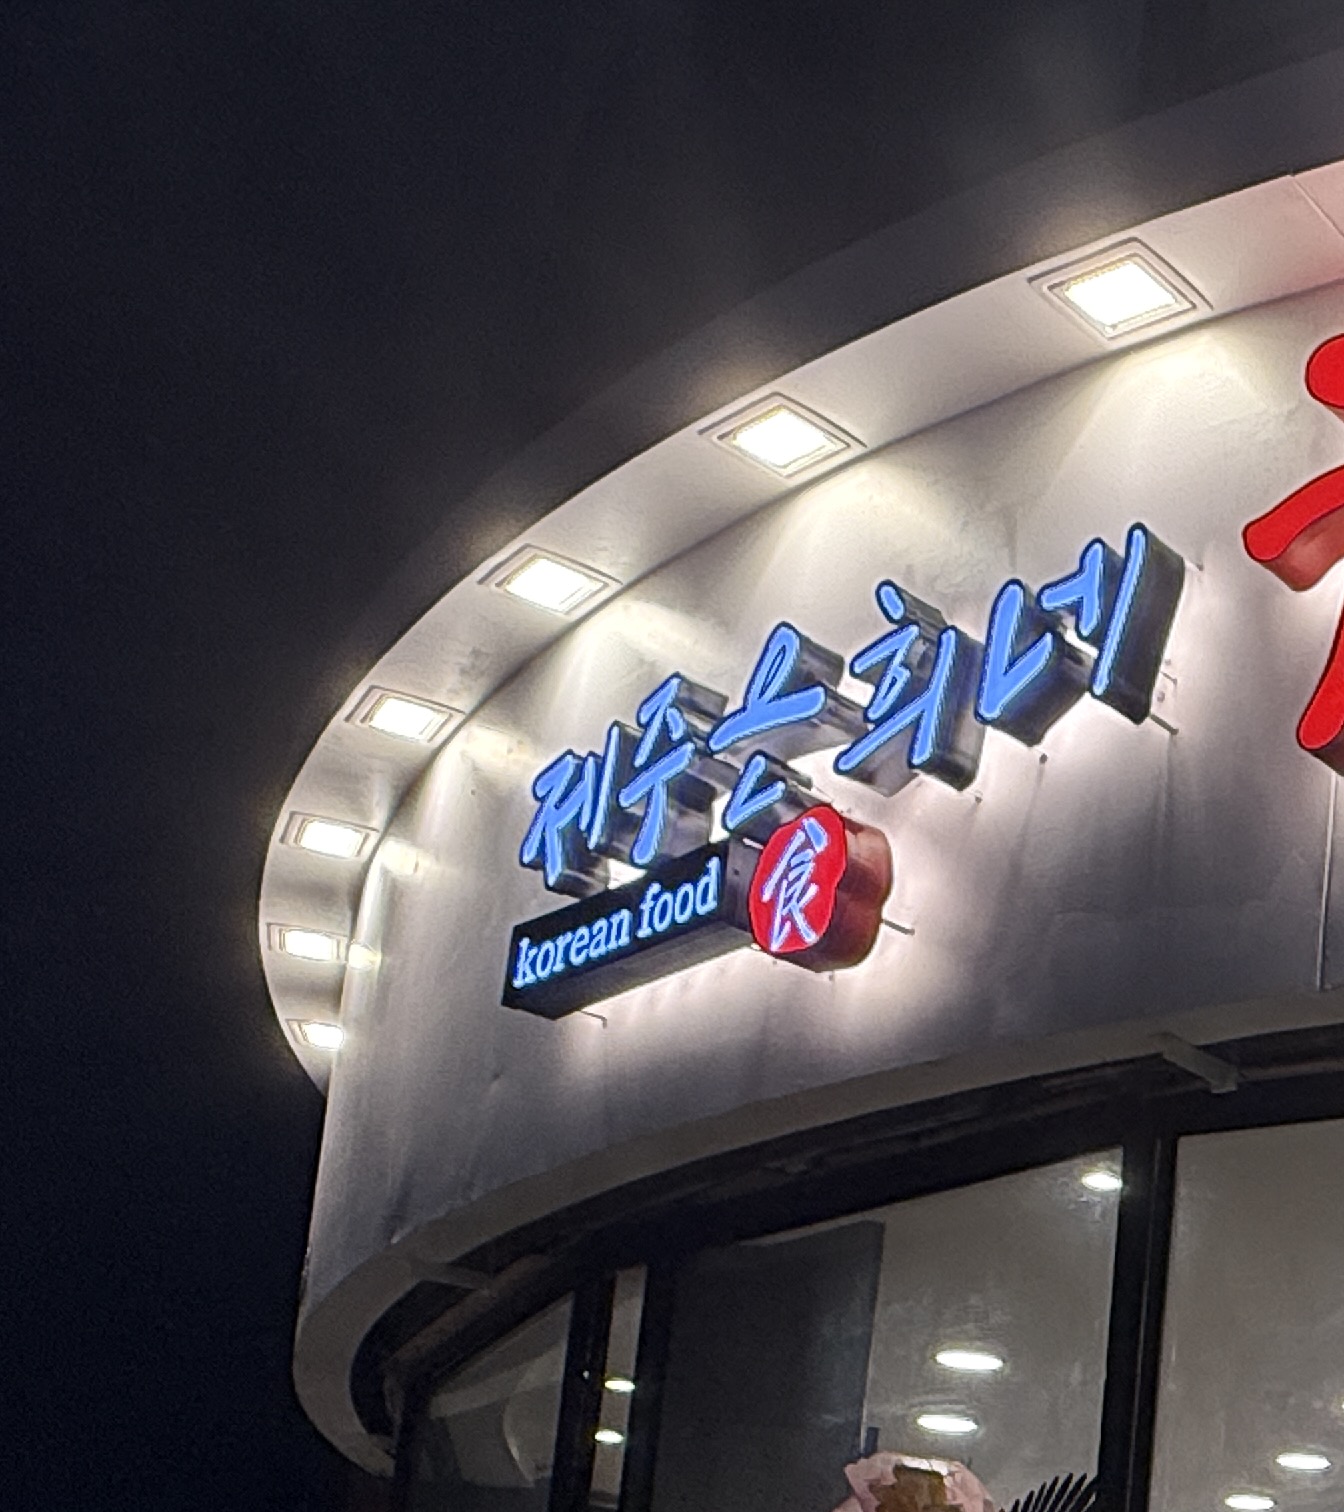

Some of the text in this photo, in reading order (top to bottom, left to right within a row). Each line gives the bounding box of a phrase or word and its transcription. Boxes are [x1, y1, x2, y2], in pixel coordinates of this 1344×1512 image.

[511, 854, 721, 989] korean food
[761, 819, 827, 950] 食
